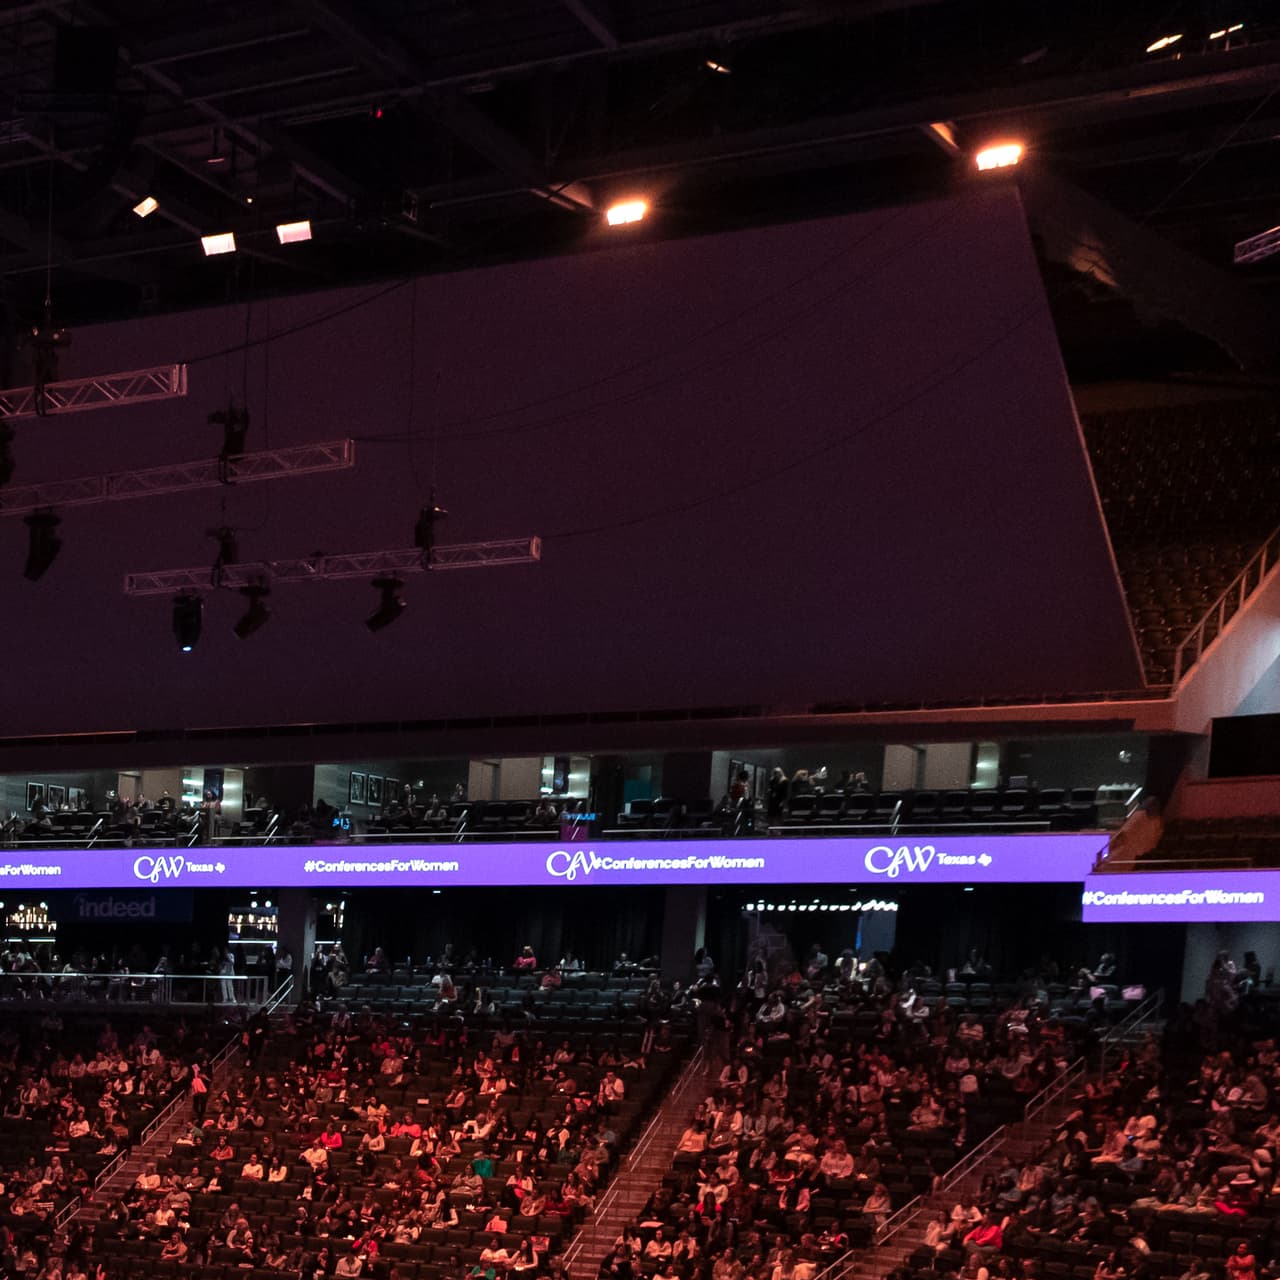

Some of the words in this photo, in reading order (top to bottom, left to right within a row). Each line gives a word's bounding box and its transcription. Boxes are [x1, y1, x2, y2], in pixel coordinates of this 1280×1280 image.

[304, 859, 458, 873] #ConferencesForWomen
[937, 853, 977, 866] Texas
[186, 862, 214, 873] Texas
[74, 894, 156, 917] indeed
